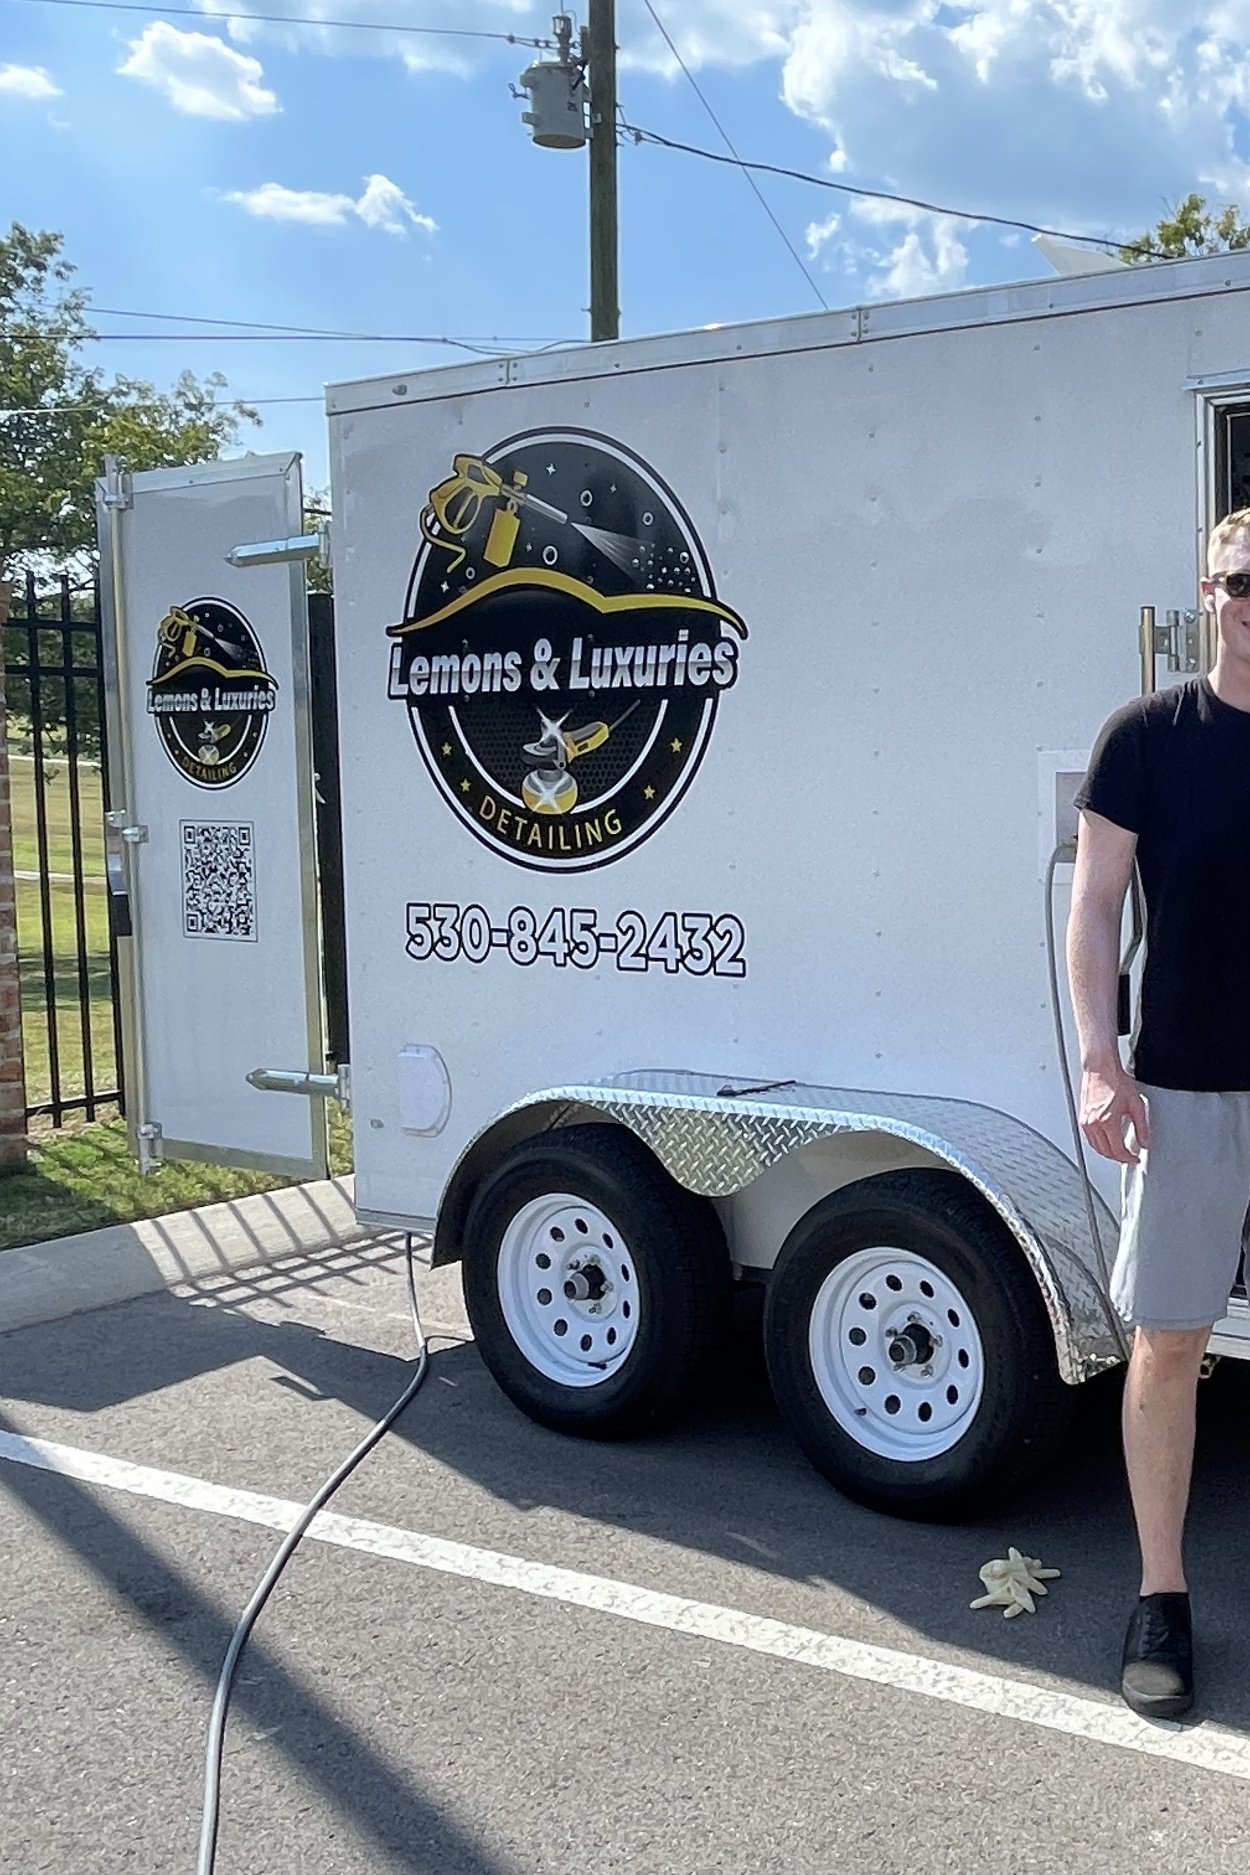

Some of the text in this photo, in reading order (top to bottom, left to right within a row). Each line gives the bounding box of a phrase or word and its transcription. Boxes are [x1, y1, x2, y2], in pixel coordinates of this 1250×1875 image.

[390, 629, 735, 696] Lemons & Luxuries
[147, 685, 274, 712] Lemons & Luxuries
[181, 756, 237, 781] DETAILING
[478, 795, 623, 850] DETAILING
[405, 903, 746, 977] 530-845-2432
